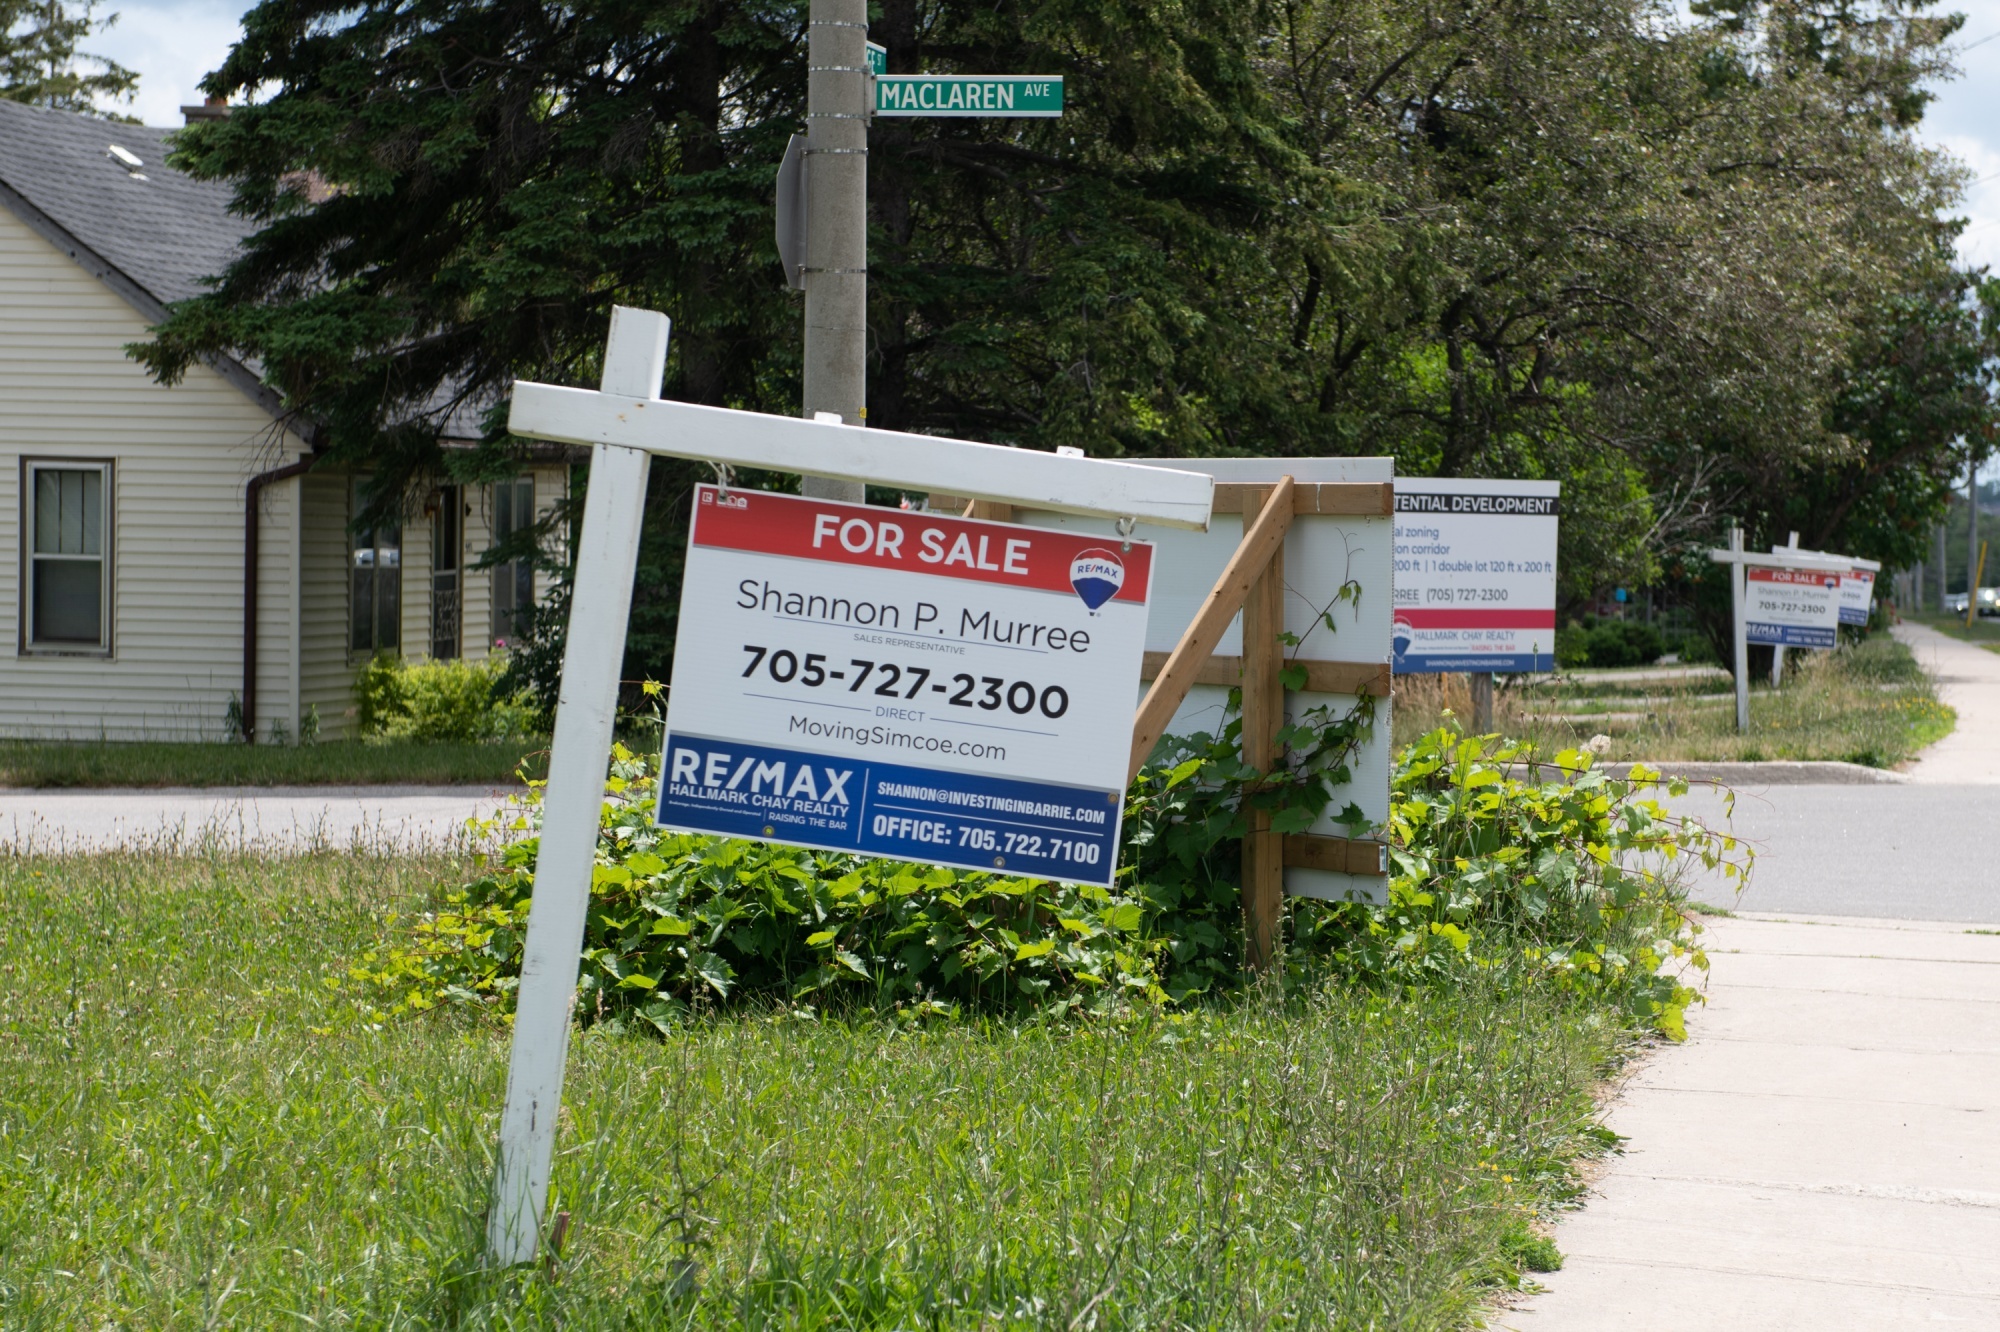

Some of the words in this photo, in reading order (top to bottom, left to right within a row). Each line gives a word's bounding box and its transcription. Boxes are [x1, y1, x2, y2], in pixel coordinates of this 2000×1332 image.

[881, 83, 1014, 109] MACLAREN
[1024, 84, 1050, 97] AVE
[1452, 497, 1553, 514] DEVELOPMENT
[1405, 526, 1439, 541] zoning
[812, 513, 904, 559] FOR
[917, 528, 1031, 575] SALE
[1411, 543, 1450, 555] corridor
[1077, 564, 1118, 579] RE/MAX
[1413, 559, 1420, 571] ft
[1438, 560, 1473, 573] double
[1475, 561, 1488, 573] lot
[1490, 561, 1505, 572] 120
[1507, 561, 1515, 573] ft
[1517, 564, 1522, 572] x
[1524, 562, 1542, 573] 200
[1544, 561, 1552, 573] ft
[1772, 571, 1791, 582] FOR
[1794, 573, 1817, 584] SALE
[1426, 588, 1454, 603] (705)
[1457, 589, 1508, 601] 727-2300
[736, 579, 899, 628] Shannon
[914, 602, 944, 634] P.
[960, 607, 1090, 653] Murree
[1758, 601, 1826, 614] 705-727-2300
[853, 633, 883, 645] SALES
[885, 637, 965, 655] REPRESENTATIVE
[1414, 631, 1458, 640] HALLMARK
[1461, 631, 1483, 640] CHAY
[1486, 631, 1516, 640] REALTY
[741, 645, 1069, 719] 705-727-2300
[875, 705, 925, 723] DIRECT
[789, 715, 1006, 760] MovingSimcoe.com
[671, 747, 853, 805] RE/MAX
[669, 783, 748, 805] HALLMARK
[751, 794, 791, 810] CHAY
[794, 800, 849, 818] REALTY
[877, 781, 1105, 825] SHANNON@INVESTINGINBARRIE.COM
[768, 811, 805, 825] RAISING
[808, 817, 826, 828] THE
[829, 819, 847, 830] BAR
[872, 814, 952, 845] OFFICE:
[958, 826, 1100, 865] 705.722.7100
